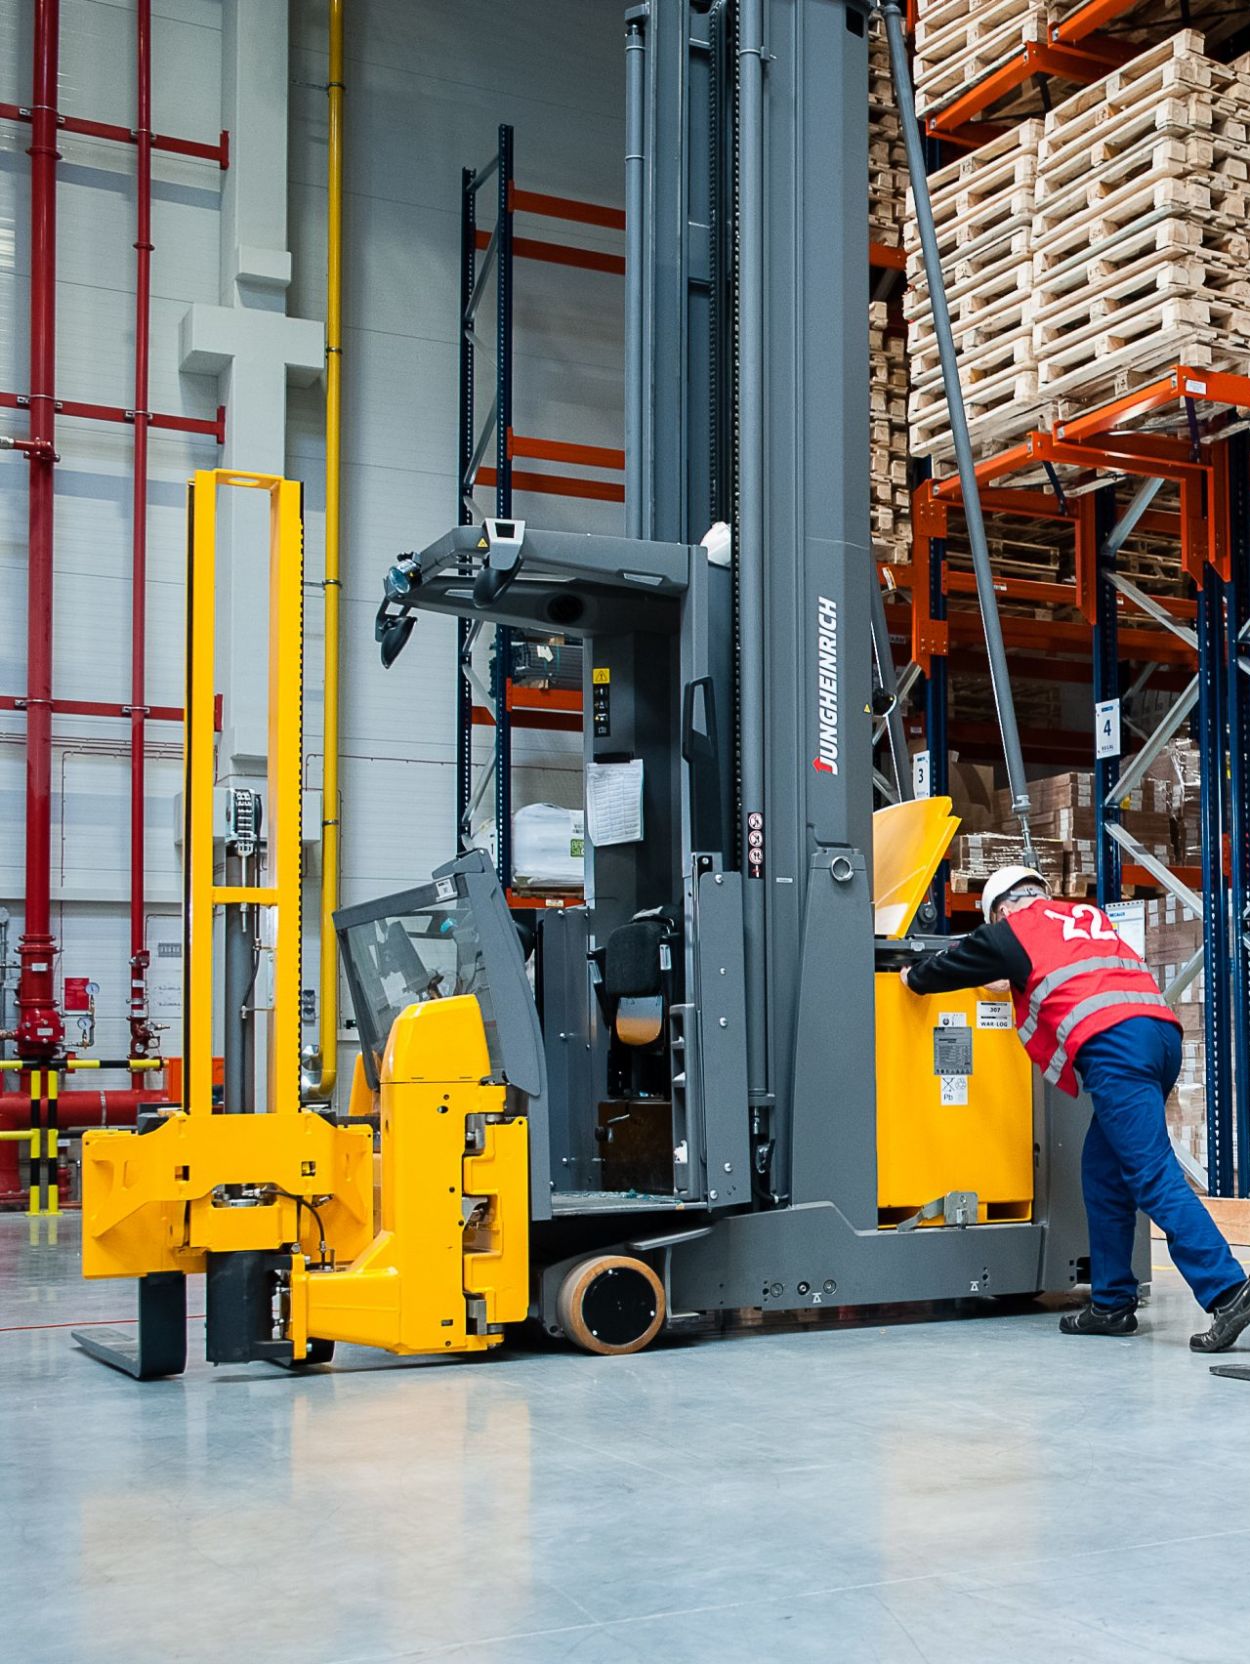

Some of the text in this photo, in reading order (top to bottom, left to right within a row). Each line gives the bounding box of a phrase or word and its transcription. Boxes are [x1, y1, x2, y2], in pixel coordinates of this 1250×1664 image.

[817, 596, 839, 776] JUNGHEINRICH
[1103, 719, 1111, 737] 4
[918, 768, 924, 783] 3
